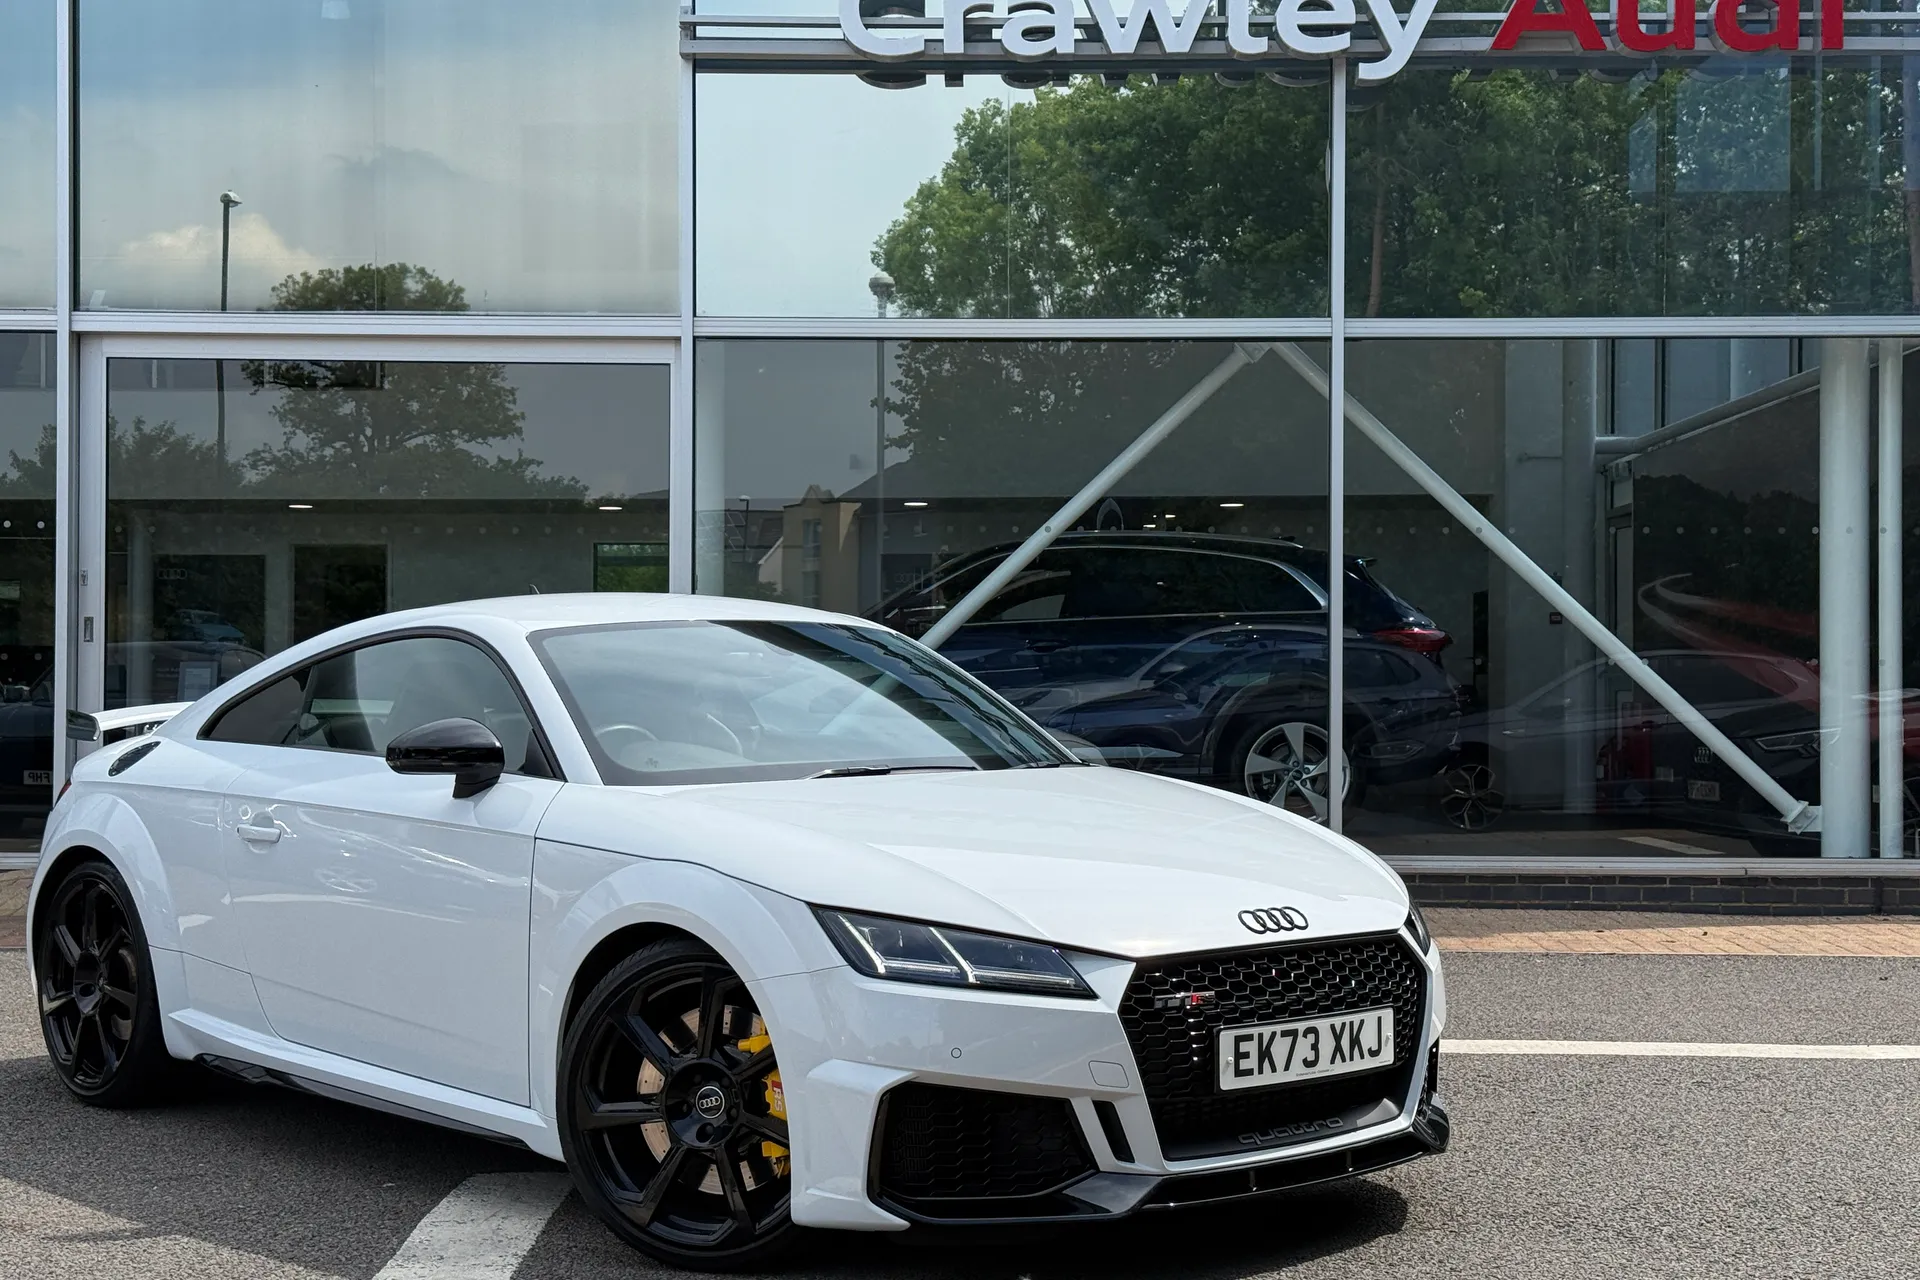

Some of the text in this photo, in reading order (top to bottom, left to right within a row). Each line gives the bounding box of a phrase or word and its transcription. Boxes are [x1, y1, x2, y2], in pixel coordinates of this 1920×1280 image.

[1234, 1016, 1383, 1078] EK73 XKJ
[1237, 1117, 1344, 1145] quattro
